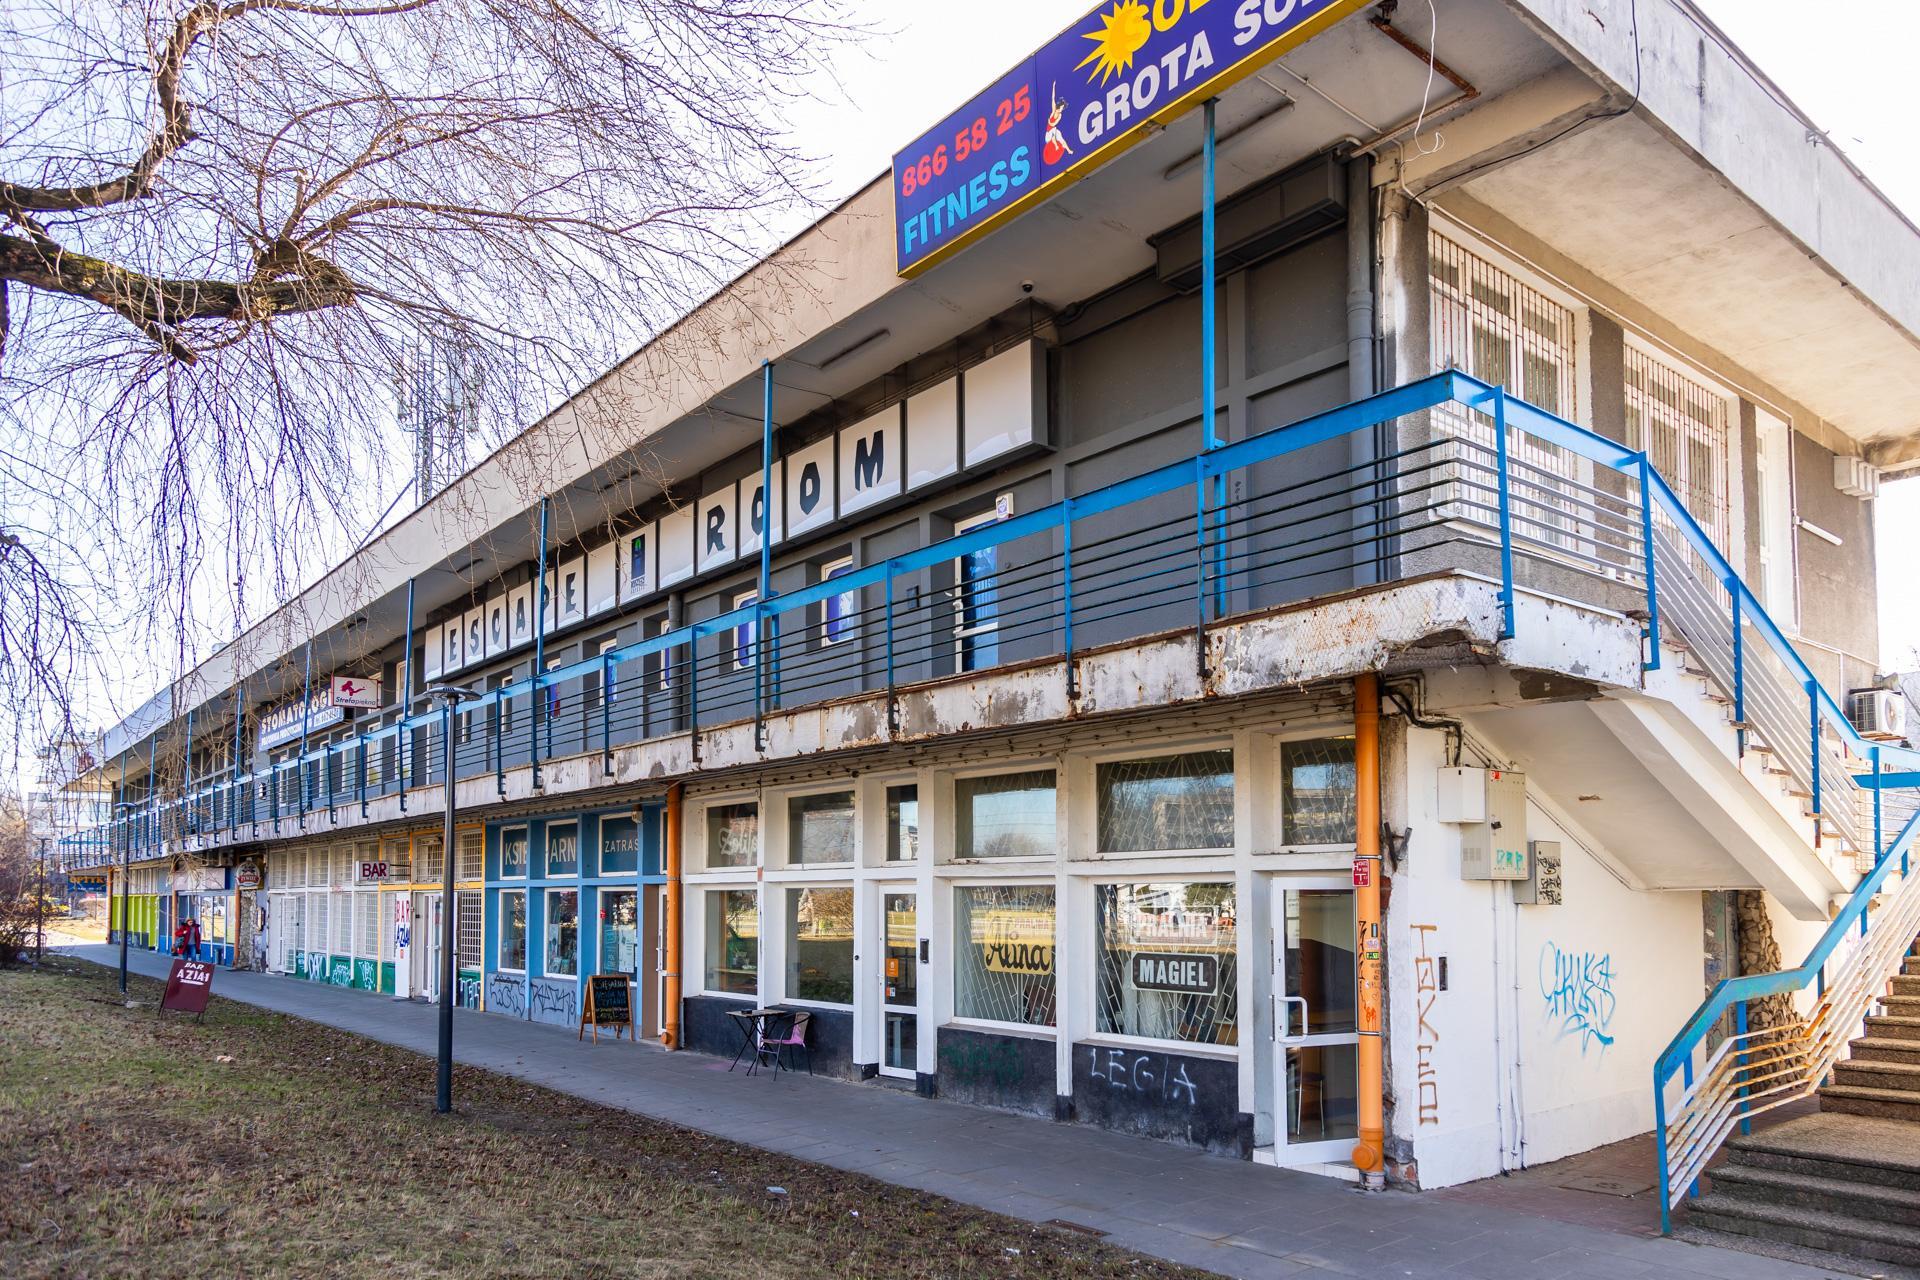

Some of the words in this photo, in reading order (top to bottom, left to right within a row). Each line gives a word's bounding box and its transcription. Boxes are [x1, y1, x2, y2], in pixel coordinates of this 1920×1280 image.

[1120, 0, 1209, 53] SO
[1079, 31, 1214, 145] GROTA
[1233, 0, 1313, 46] SO
[902, 144, 948, 197] 866
[955, 117, 988, 162] 58
[996, 84, 1031, 136] 25
[903, 146, 1031, 255] FITNESS
[706, 429, 884, 556] ROOM
[362, 862, 387, 878] BAR
[184, 962, 205, 971] BAR
[1139, 959, 1209, 987] MAGIEL
[1090, 1047, 1197, 1105] LEGIA
